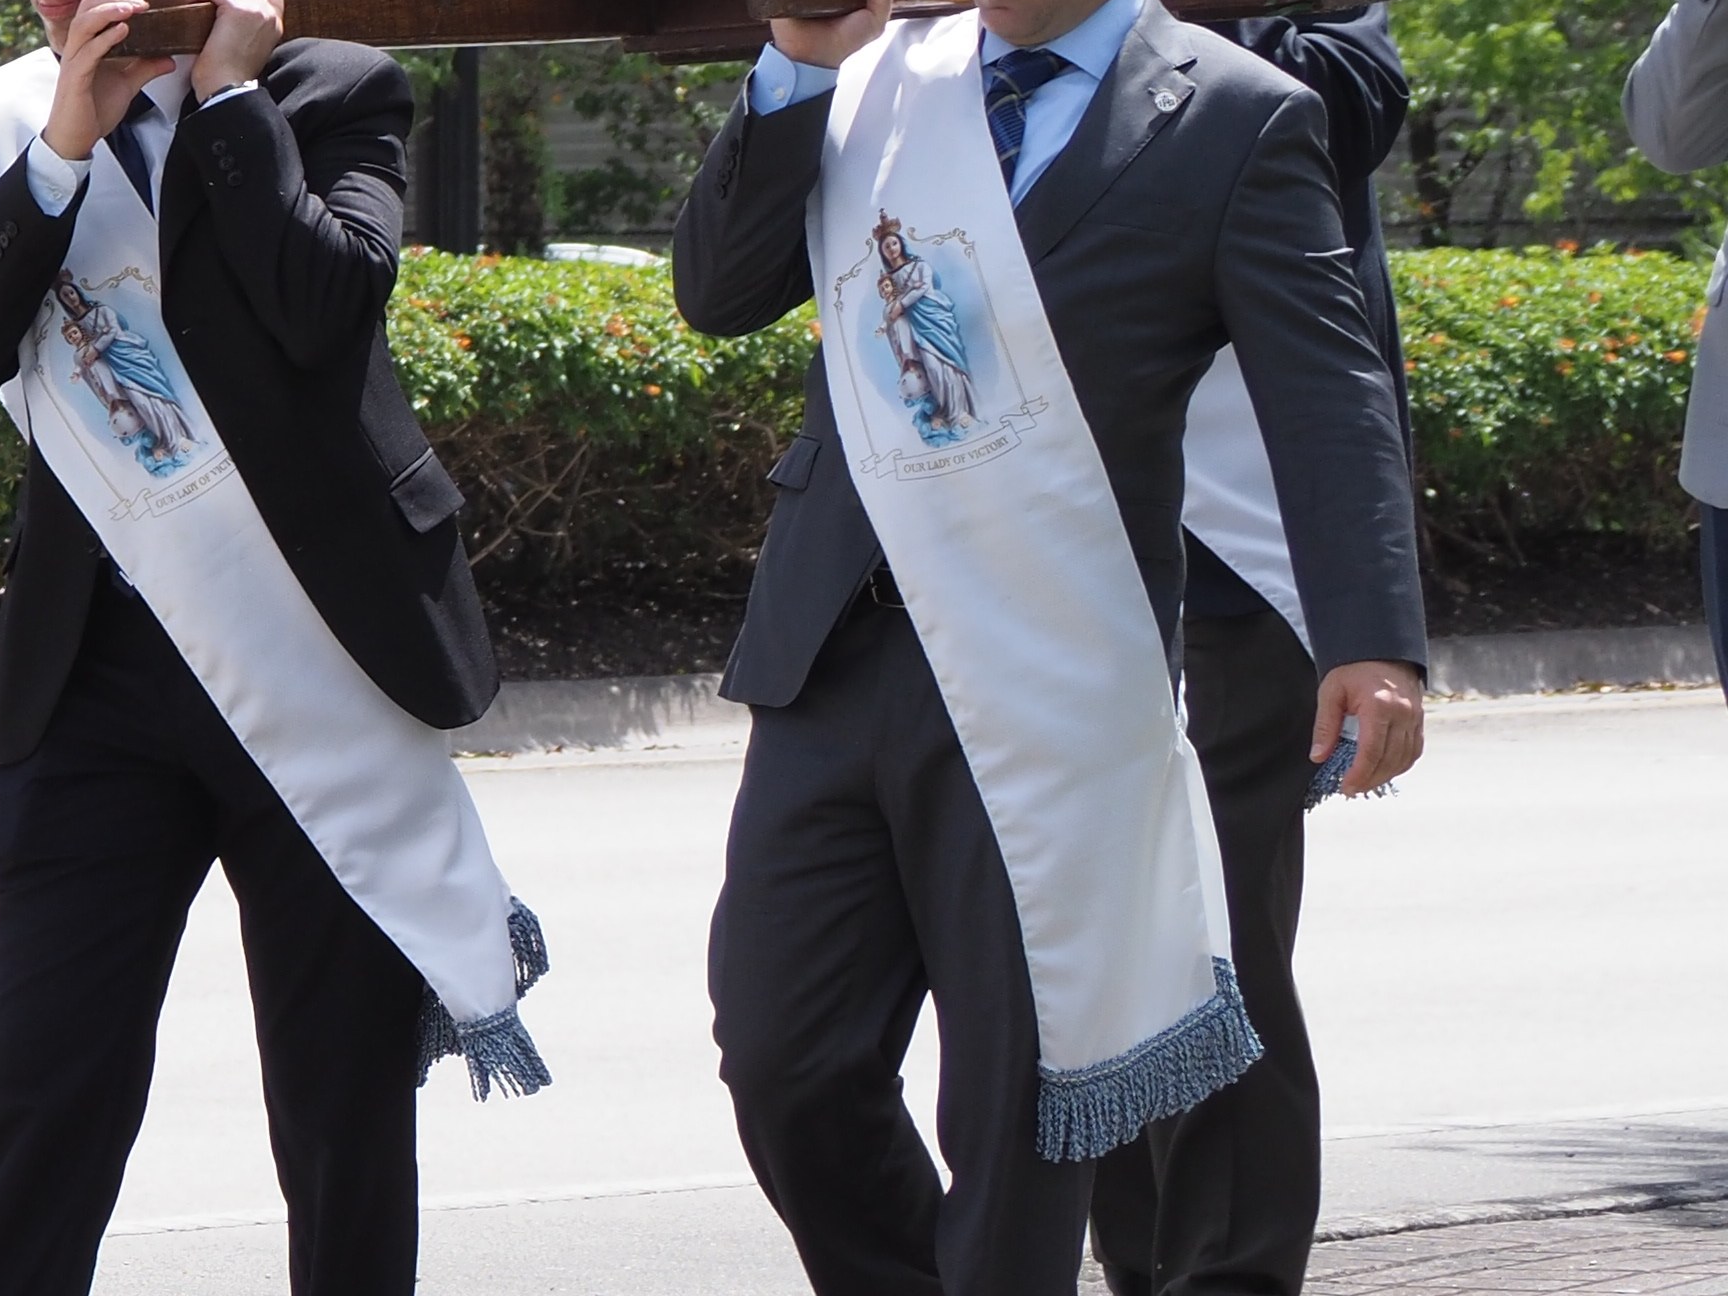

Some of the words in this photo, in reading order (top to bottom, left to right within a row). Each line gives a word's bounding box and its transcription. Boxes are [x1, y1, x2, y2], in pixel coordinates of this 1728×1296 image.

[903, 463, 926, 473] OUR
[928, 457, 952, 471] LADY
[953, 453, 966, 465] OF
[968, 435, 1009, 460] VICTORY
[155, 493, 176, 508] OUR
[176, 481, 199, 499] LADY
[199, 473, 211, 486] OF
